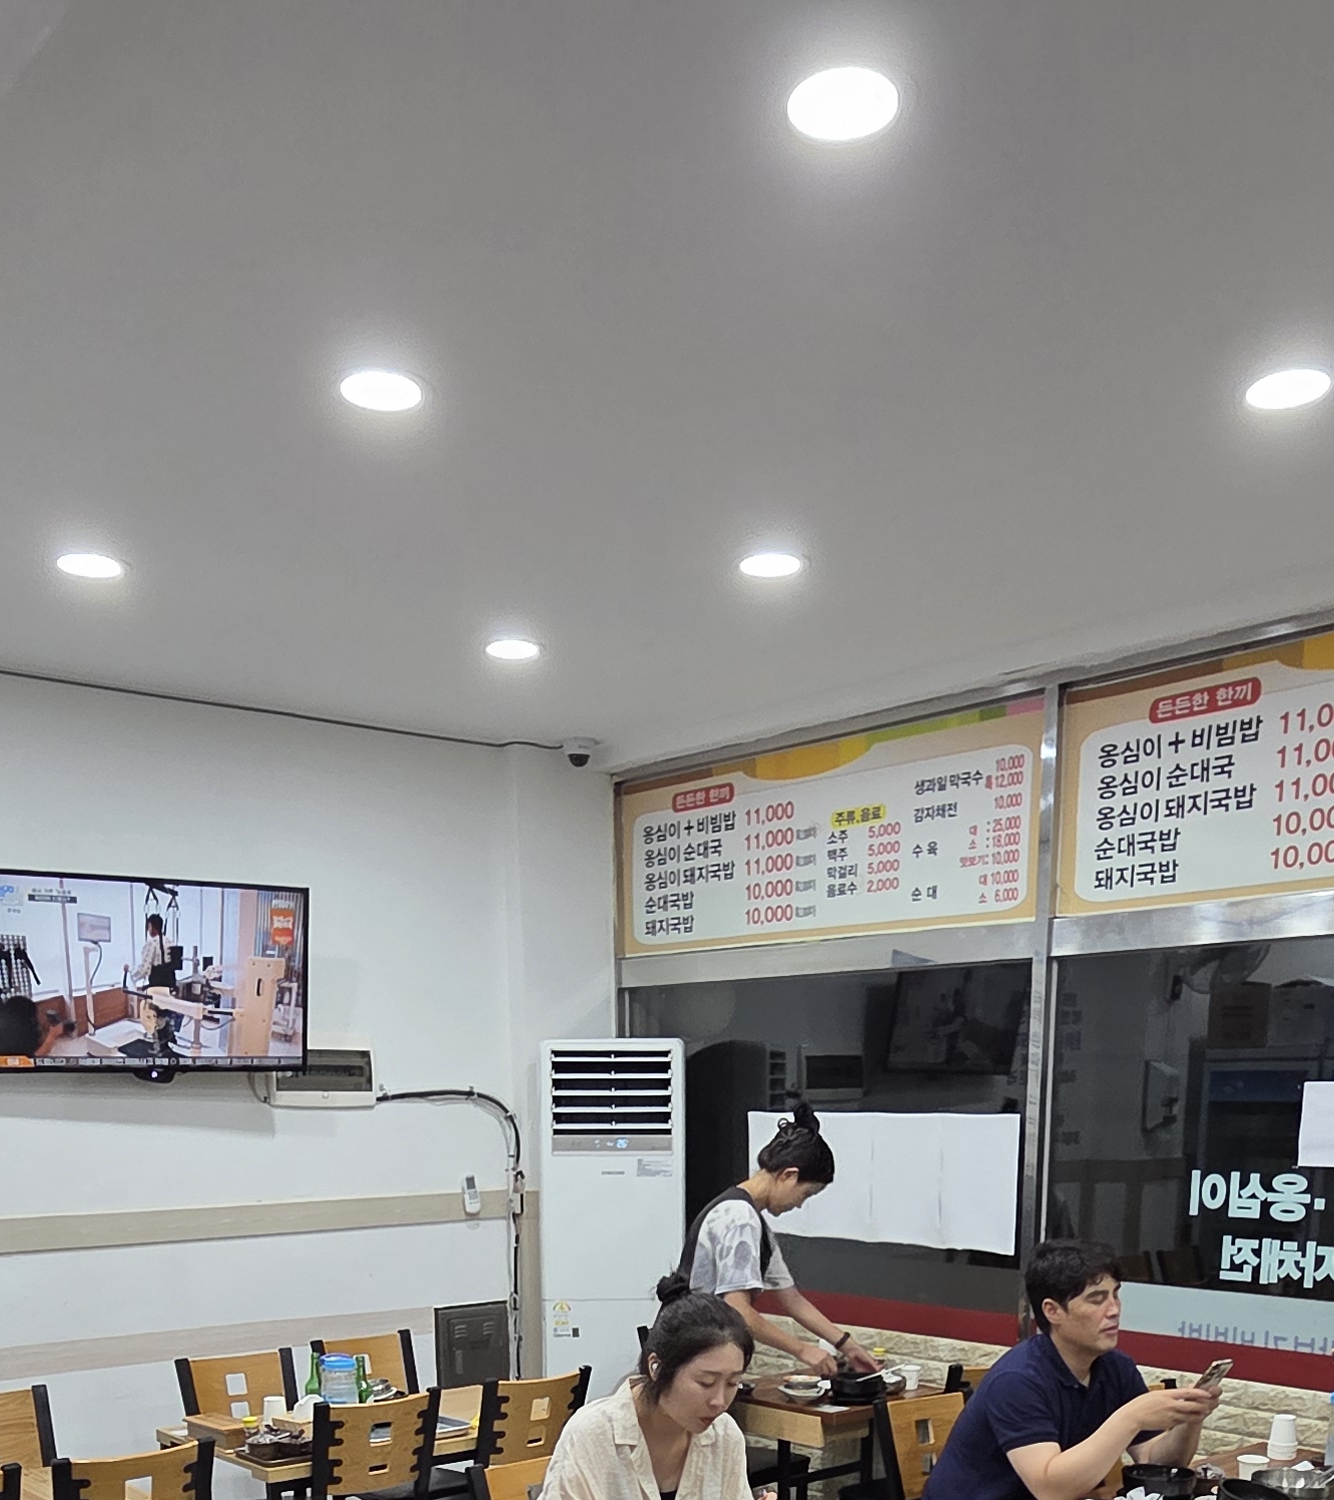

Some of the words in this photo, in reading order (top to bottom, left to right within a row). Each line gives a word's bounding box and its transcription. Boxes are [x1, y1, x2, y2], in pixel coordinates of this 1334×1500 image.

[1157, 692, 1209, 718] 든든한
[1216, 683, 1253, 707] 한끼
[1099, 736, 1162, 769] 옹심이
[1168, 732, 1185, 753] +
[1191, 715, 1263, 748] 비빔밥
[1097, 767, 1162, 799] 옹심이
[1166, 755, 1235, 788] 순대국
[1096, 799, 1160, 831] 옹심이
[1164, 784, 1256, 819] 돼지국밥
[1095, 828, 1181, 861] 순대국밥
[1094, 859, 1179, 891] 돼지국밥
